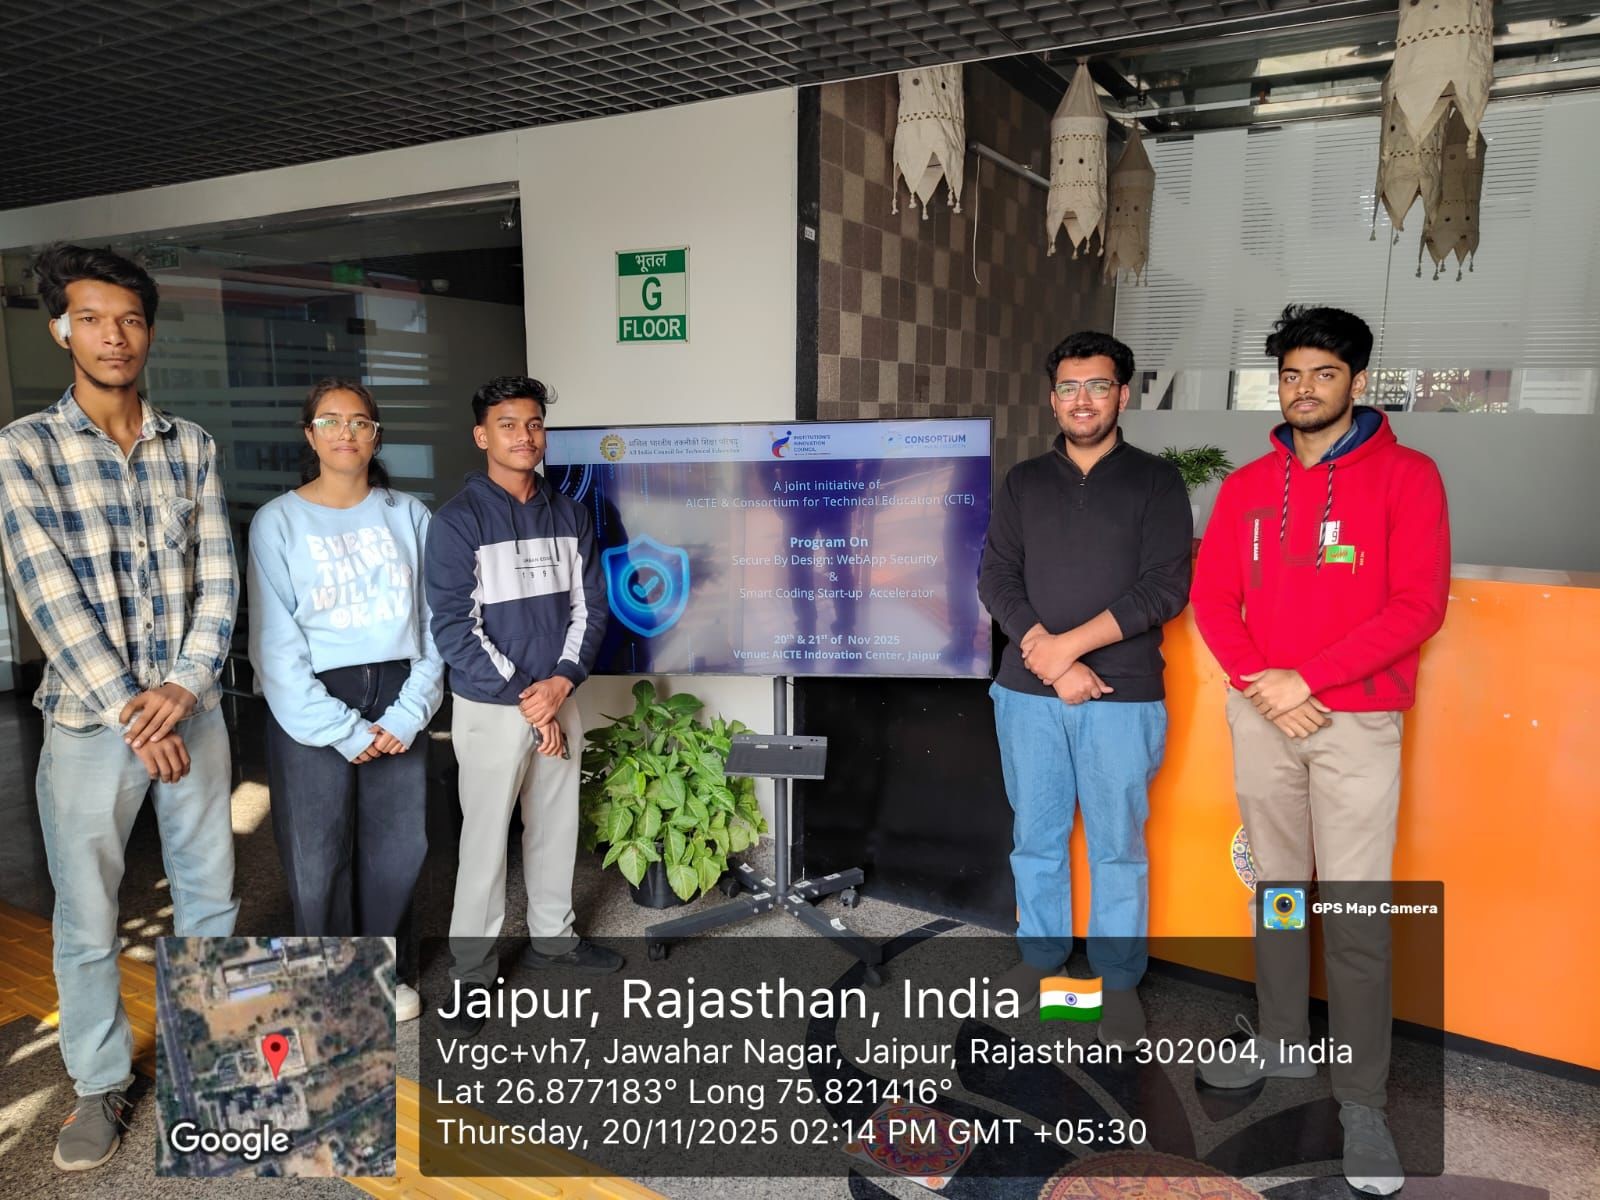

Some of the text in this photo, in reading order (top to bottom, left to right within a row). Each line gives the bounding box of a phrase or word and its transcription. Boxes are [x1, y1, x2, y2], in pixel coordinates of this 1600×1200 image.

[635, 253, 667, 273] भूतल
[641, 276, 662, 311] G
[623, 318, 681, 338] FLOOR
[904, 434, 966, 444] CONSORTIUM
[773, 479, 881, 493] A joint initiative of
[686, 494, 975, 508] AICTE & Consortium for Technical Education (CTE)
[790, 537, 869, 550] Program On
[316, 540, 399, 587] THING
[732, 553, 938, 567] Secure By Design: WebApp Security
[828, 572, 838, 582] &
[311, 574, 378, 612] WILL
[739, 587, 935, 600] Smart Coding Start-up Accelerator
[797, 635, 806, 645] &
[830, 634, 843, 645] of
[848, 635, 871, 645] Nov
[874, 634, 900, 645] 2025
[733, 649, 942, 662] Venue: AICTE Indovation Center, Jaipur
